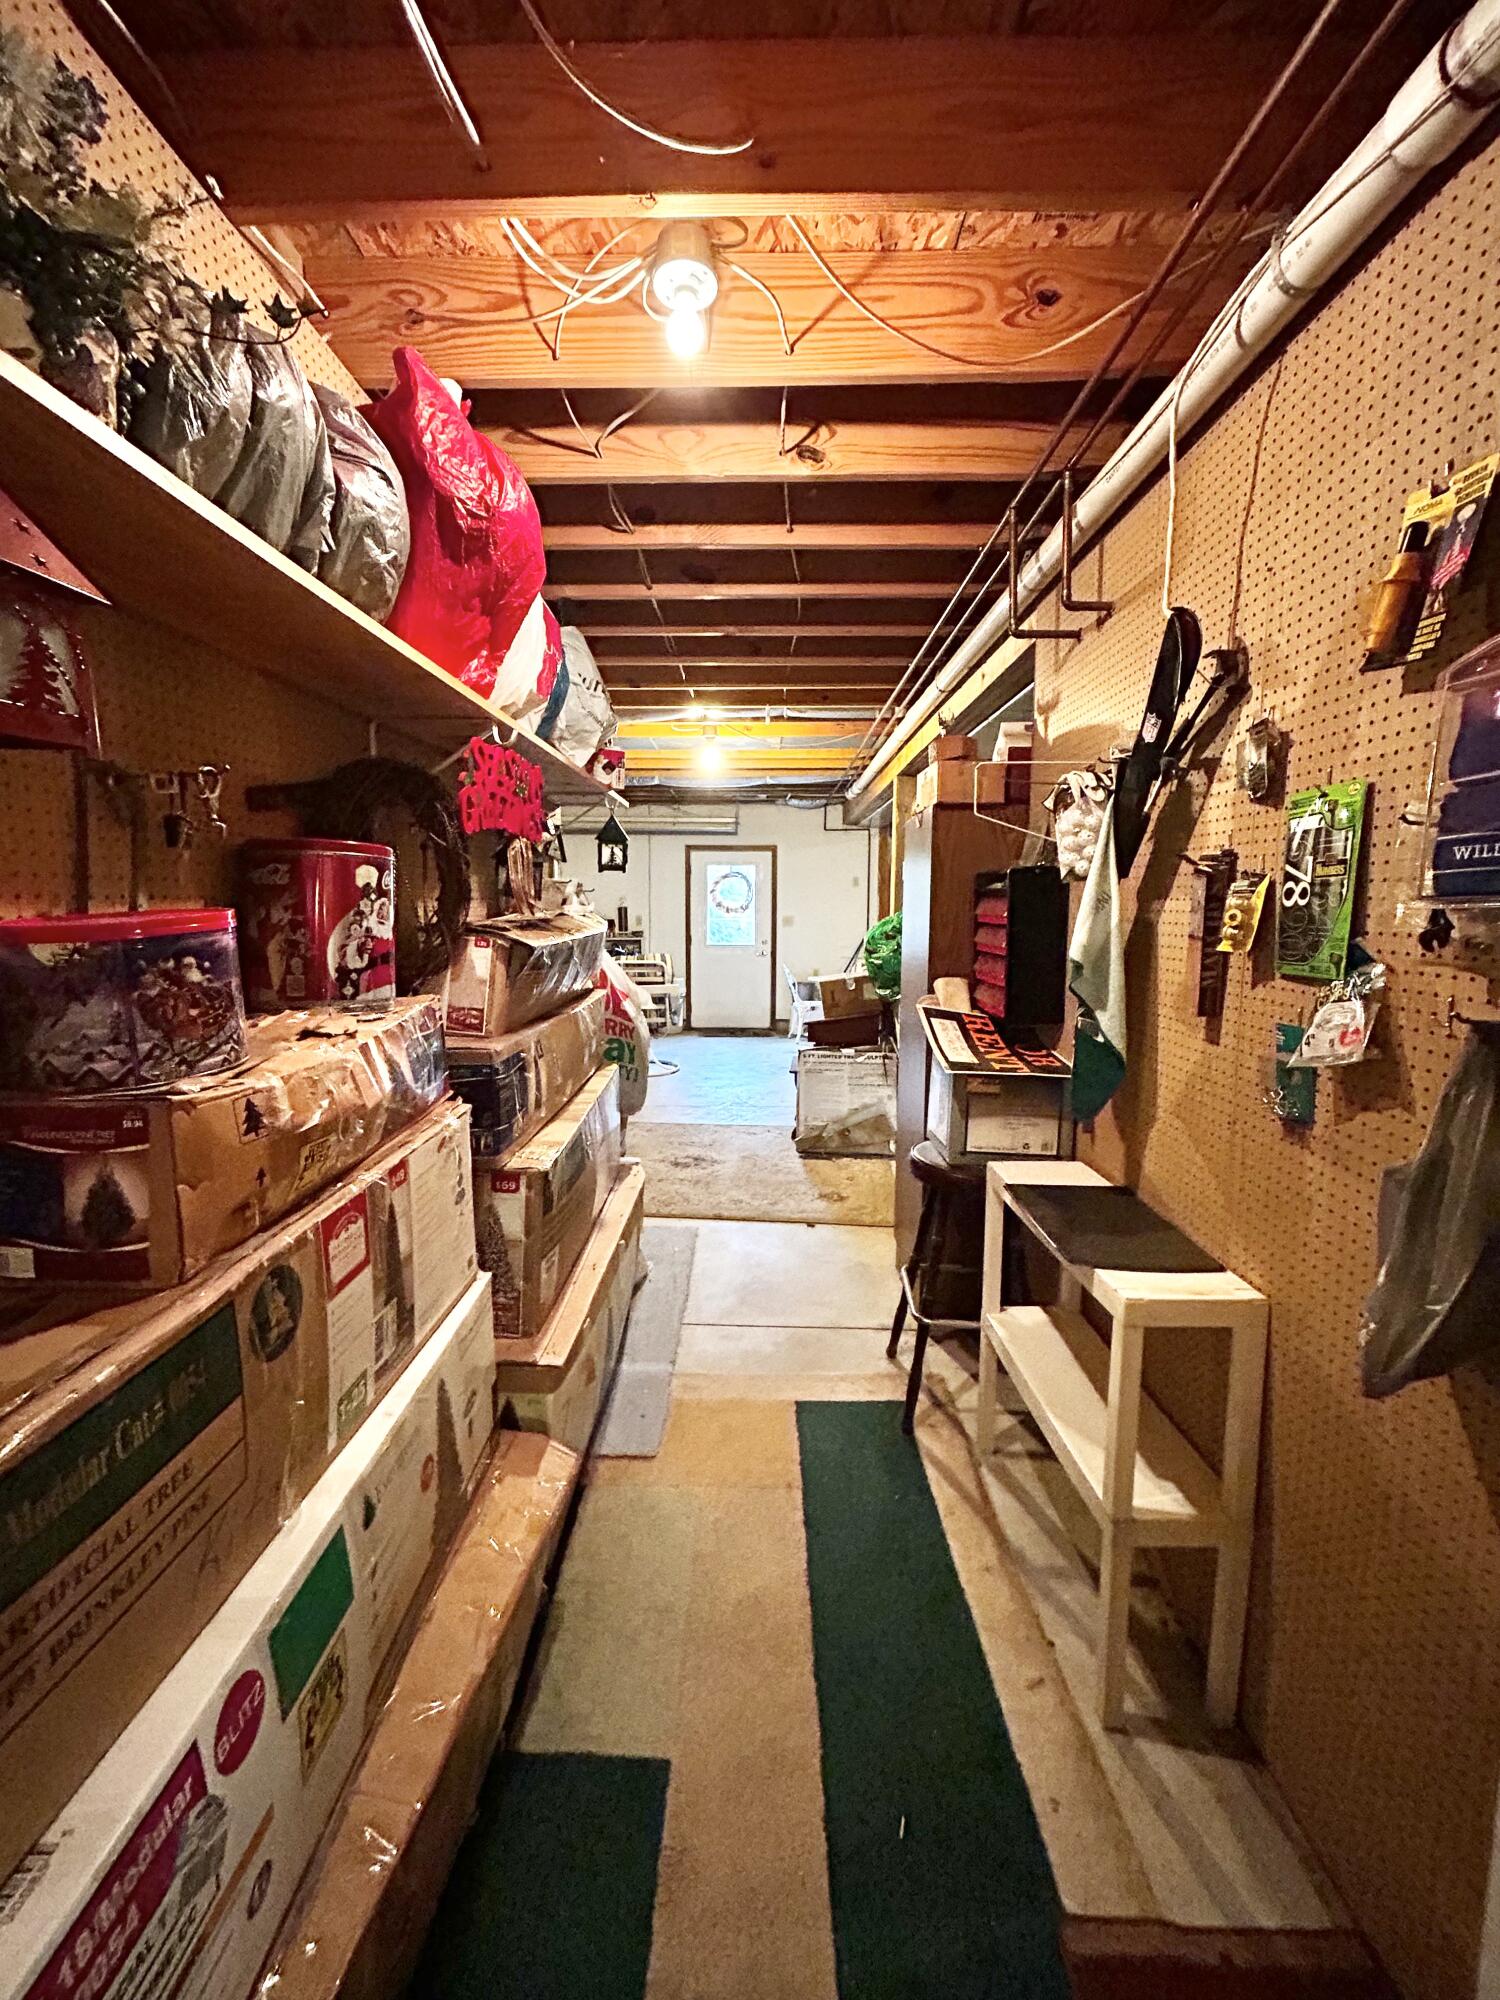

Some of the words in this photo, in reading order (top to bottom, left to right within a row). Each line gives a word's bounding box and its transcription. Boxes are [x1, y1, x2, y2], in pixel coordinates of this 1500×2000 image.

[961, 1012, 1031, 1073] RENT
[0, 1515, 138, 1653] RTIFICIAL
[142, 1457, 194, 1522] TREE
